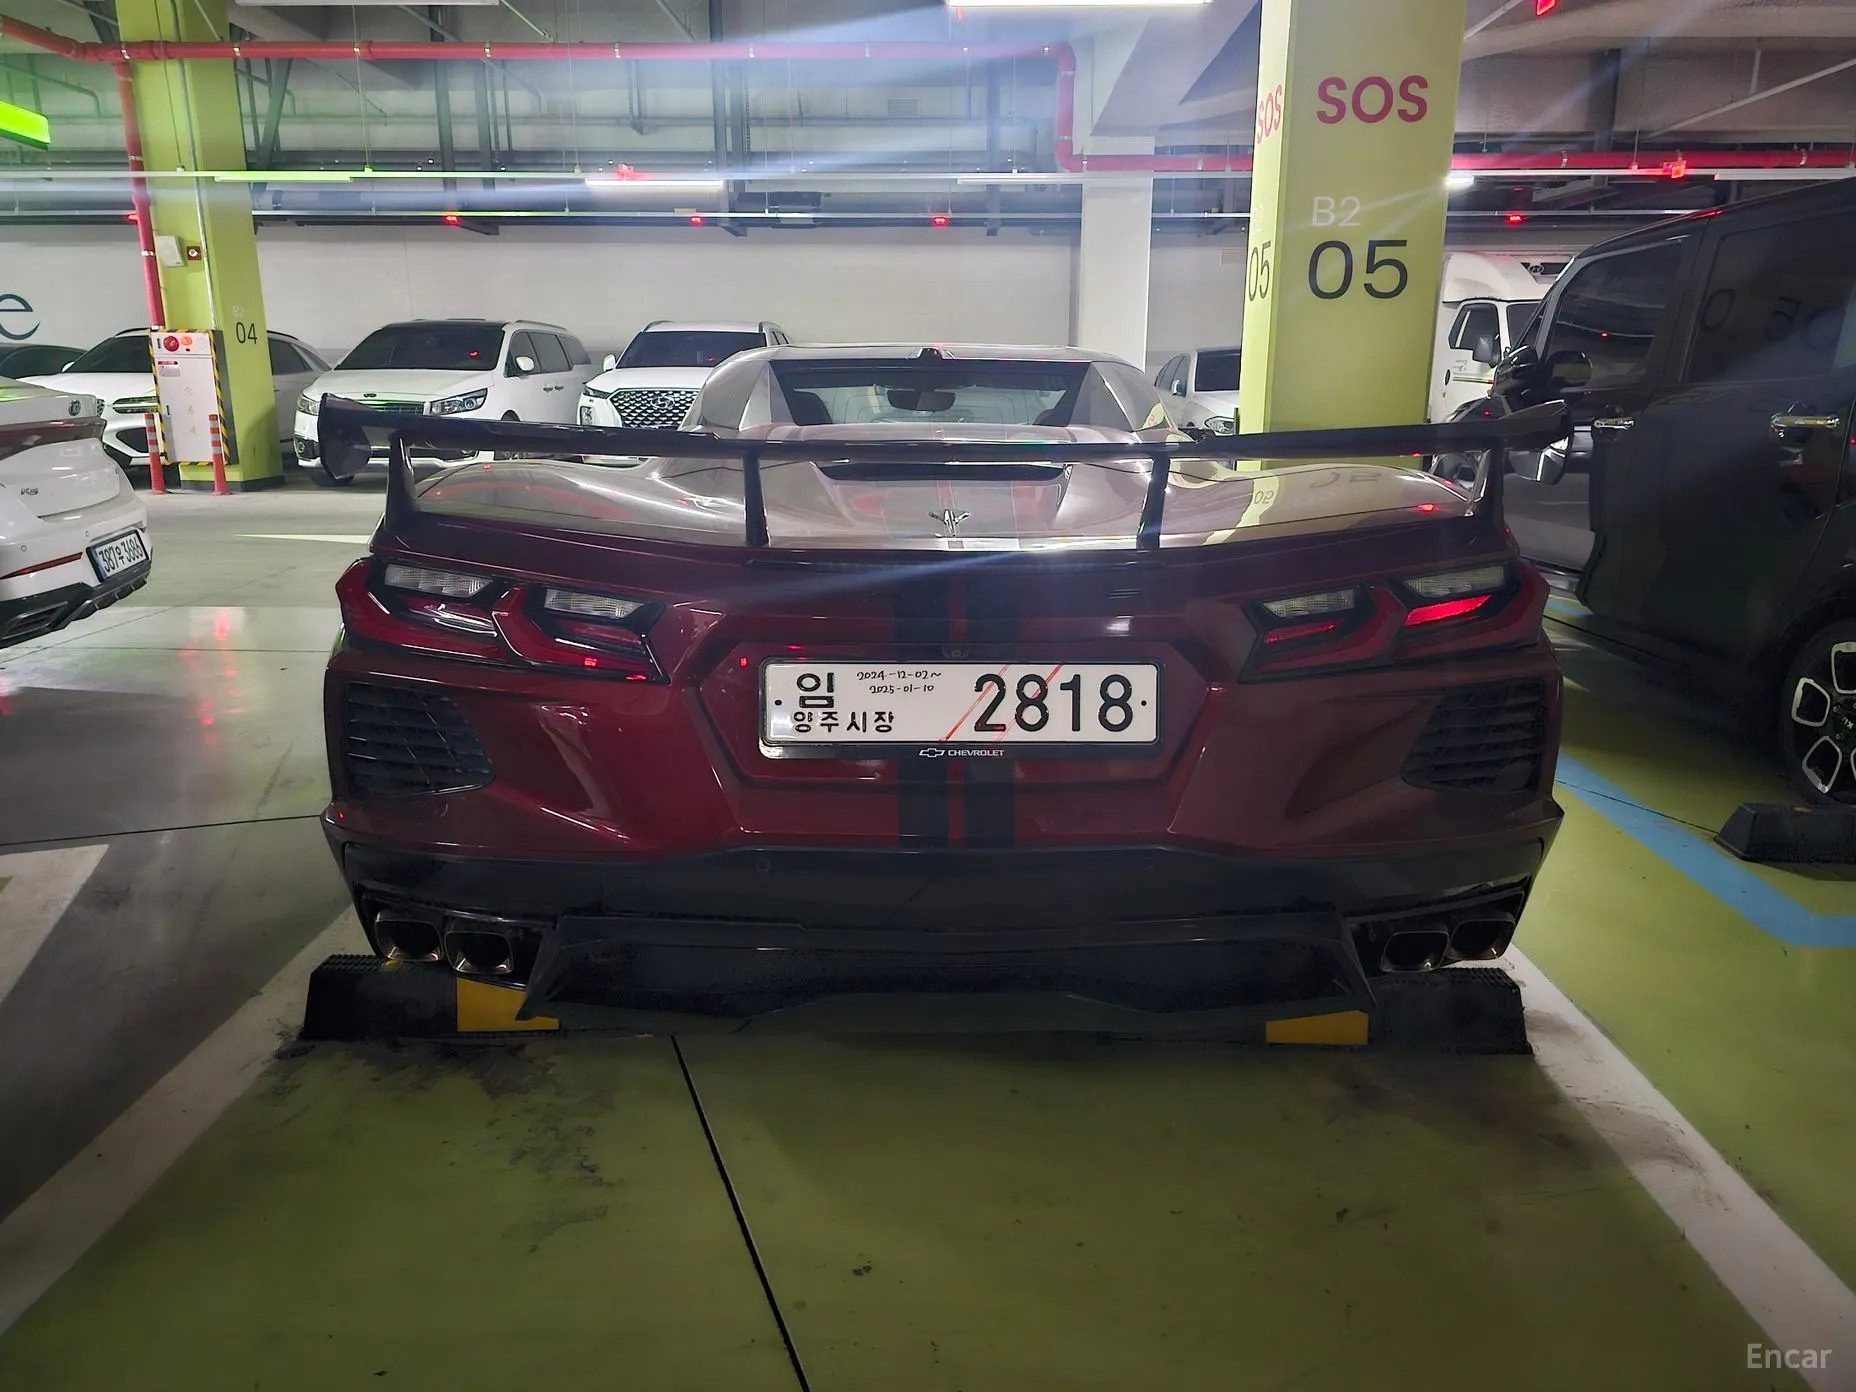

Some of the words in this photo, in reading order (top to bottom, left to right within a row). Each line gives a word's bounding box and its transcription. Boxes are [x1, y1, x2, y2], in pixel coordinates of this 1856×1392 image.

[1257, 84, 1283, 144] SOS
[1316, 75, 1429, 124] SOS
[1310, 195, 1362, 227] B2
[1248, 241, 1272, 301] 05
[1308, 239, 1409, 300] 05
[235, 321, 258, 345] 04
[796, 672, 835, 709] 임
[869, 684, 935, 694] 2025-01-10
[974, 673, 1134, 732] 2818
[793, 711, 895, 733] 양주시장
[947, 749, 1005, 757] CHEVROLET
